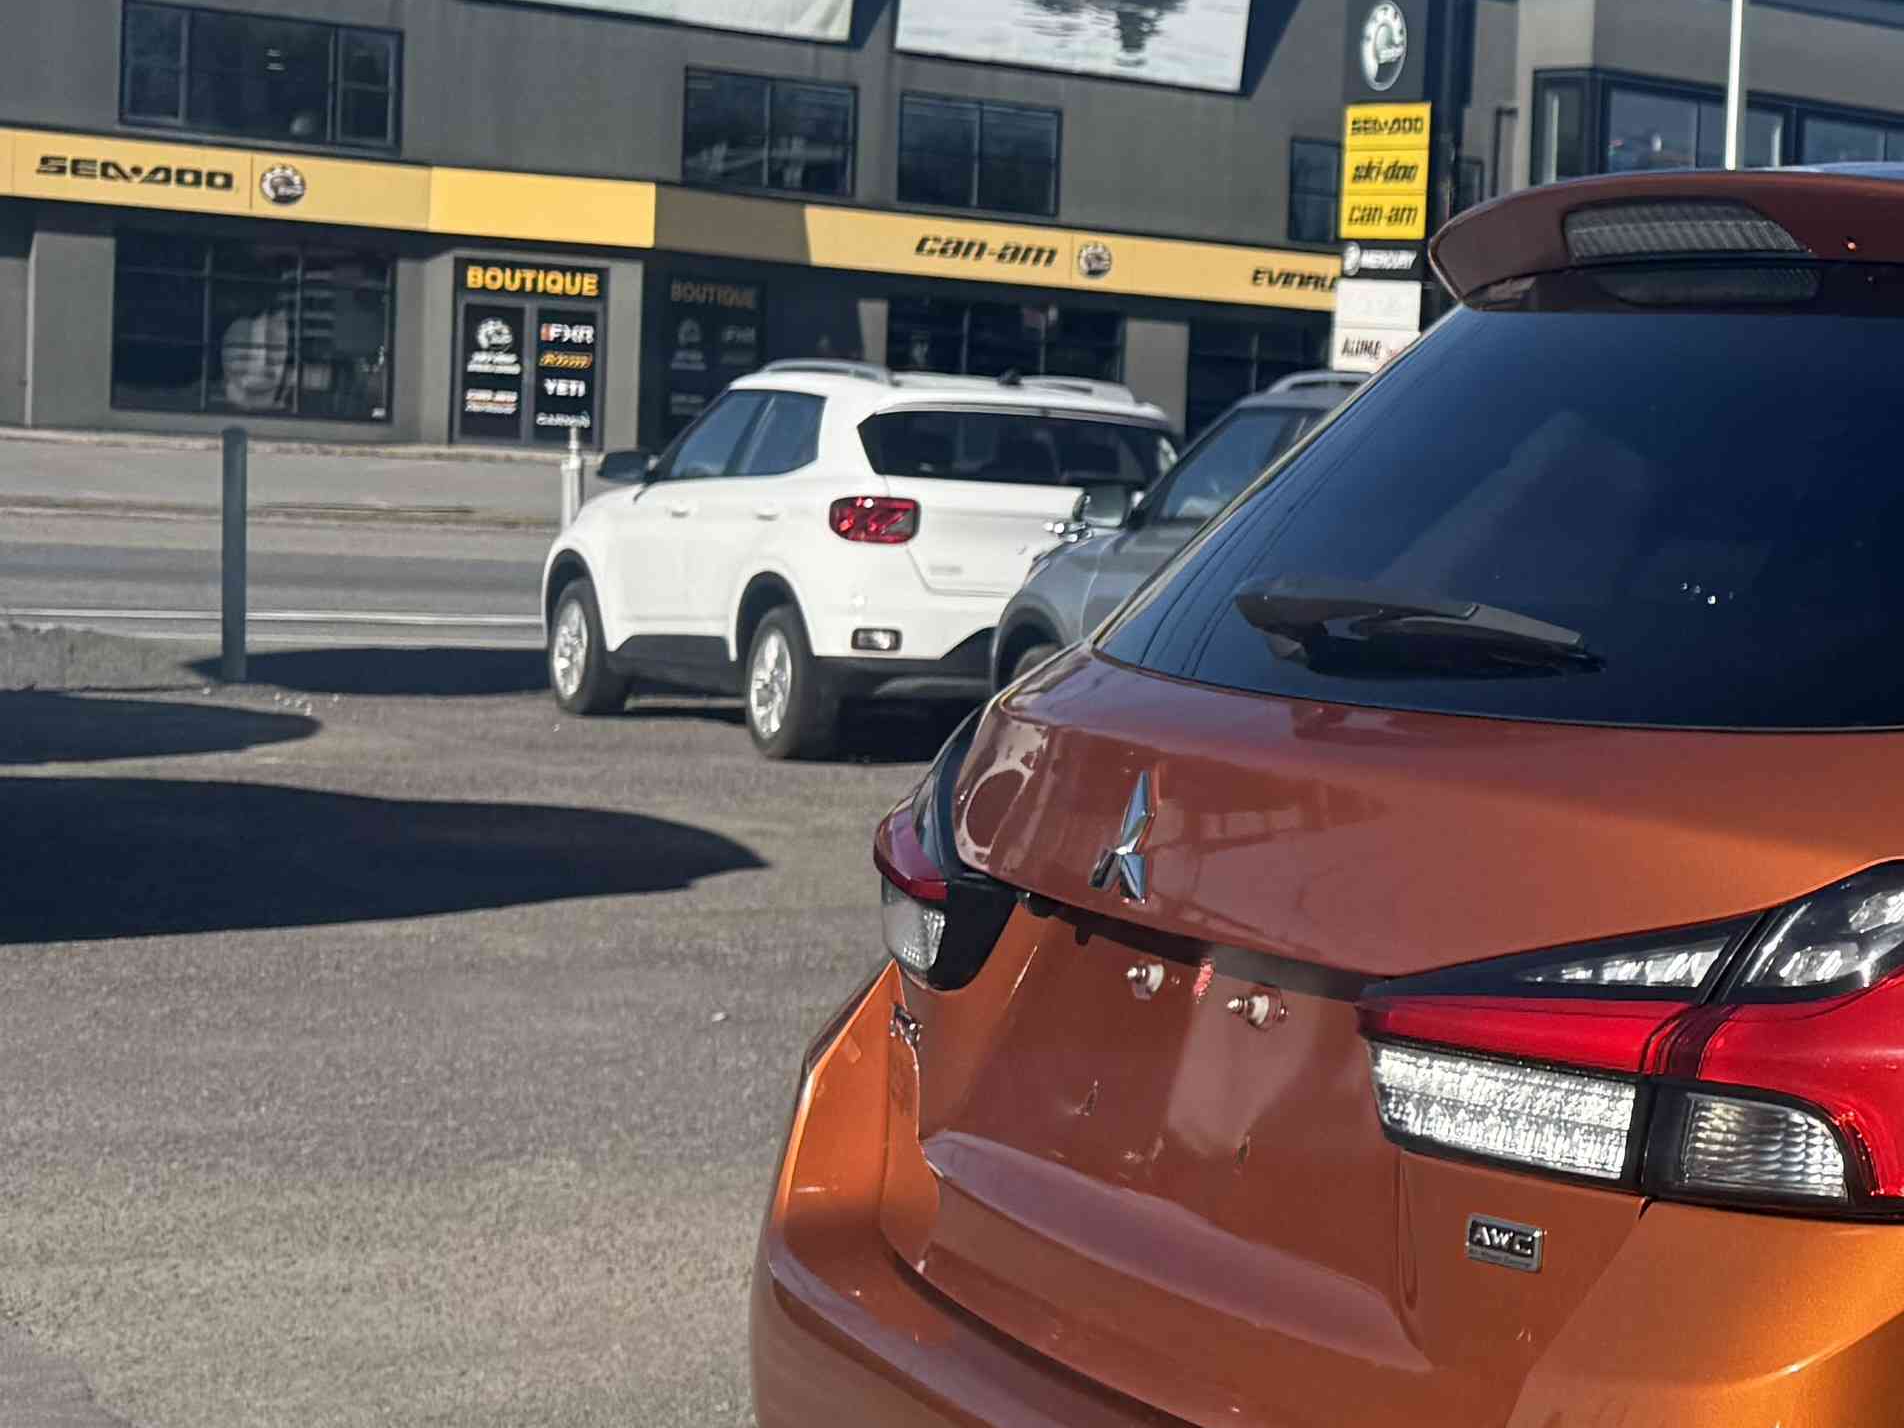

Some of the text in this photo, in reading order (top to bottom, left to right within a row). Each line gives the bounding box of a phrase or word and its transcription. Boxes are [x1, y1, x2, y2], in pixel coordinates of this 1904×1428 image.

[1349, 203, 1418, 227] can-am
[914, 233, 1059, 269] can-am
[466, 264, 600, 298] BOUTIQUE
[1251, 265, 1336, 294] EVINRU
[543, 377, 587, 398] YETI
